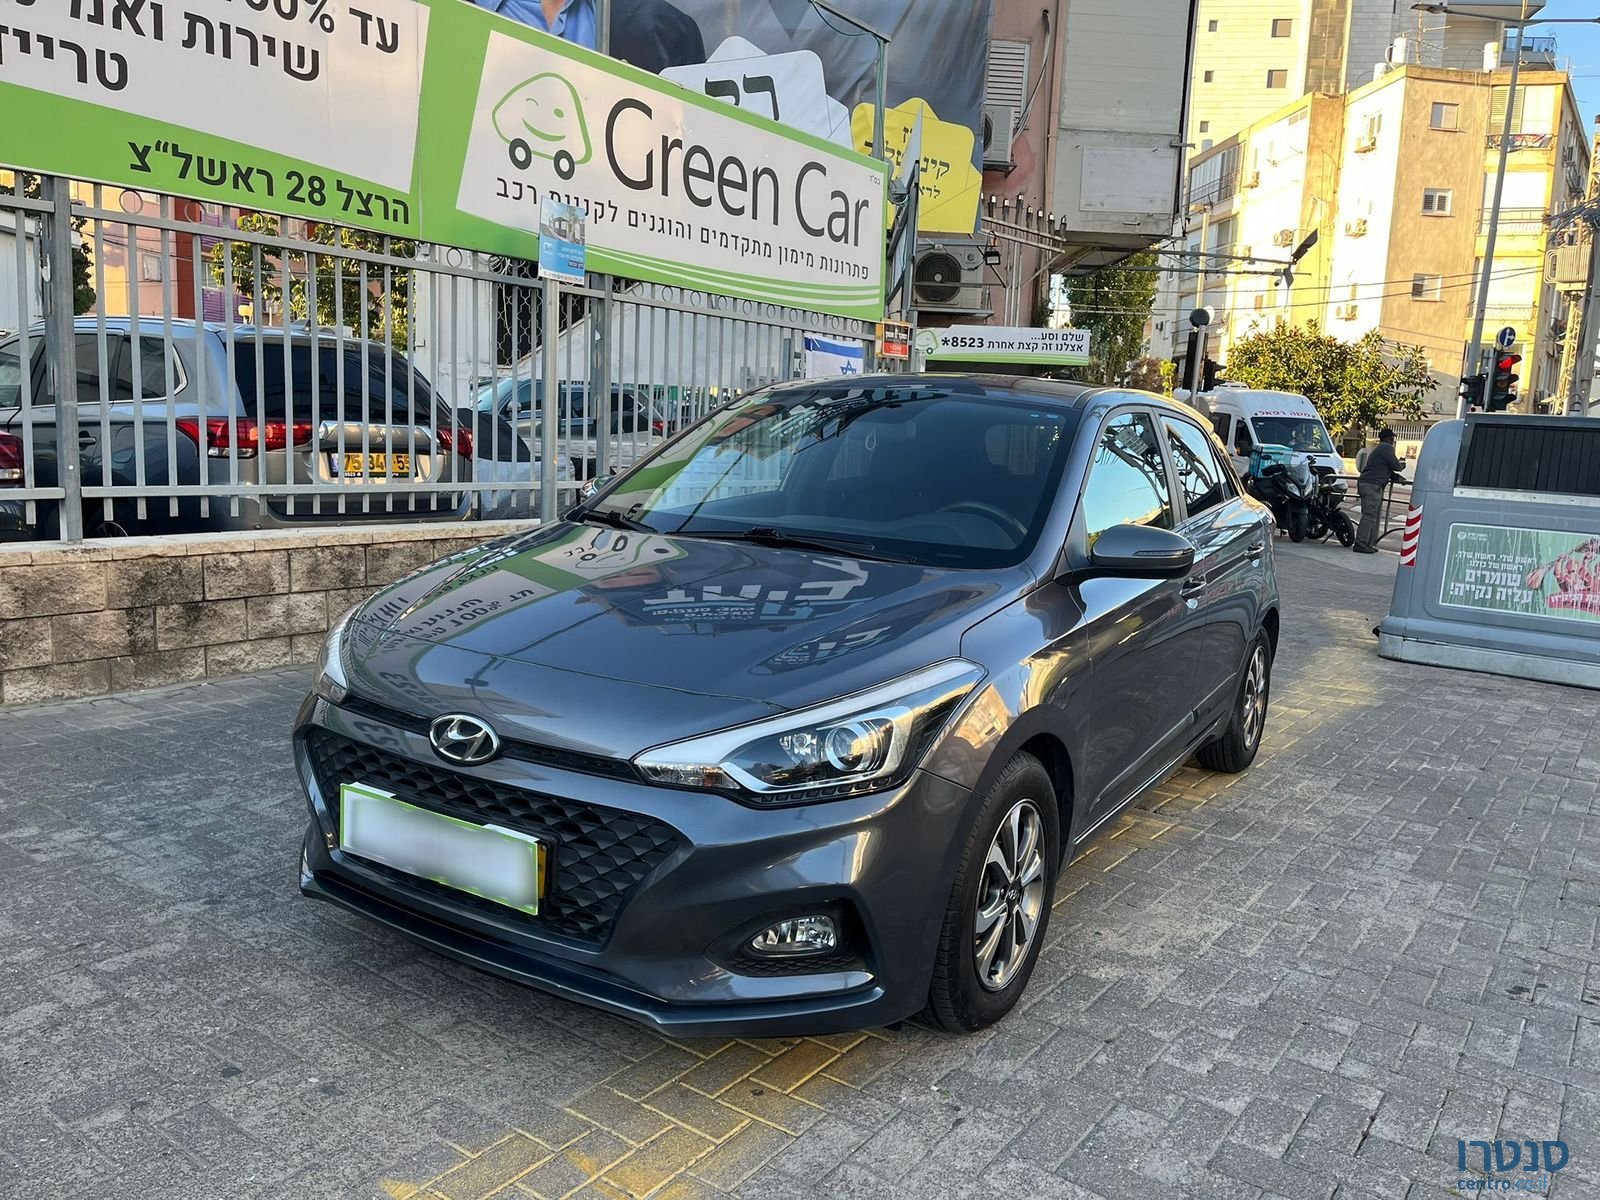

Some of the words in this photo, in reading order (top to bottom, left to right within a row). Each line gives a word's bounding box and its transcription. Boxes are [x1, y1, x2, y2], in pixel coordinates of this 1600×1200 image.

[348, 7, 399, 54] עד
[182, 11, 320, 82] שירות
[605, 98, 779, 226] Green
[795, 161, 869, 247] Car
[285, 170, 327, 207] 28
[496, 177, 537, 205] רכב
[336, 179, 409, 224] הרצל
[628, 209, 692, 240] והוגנים
[700, 226, 773, 259] מתקדמים
[779, 244, 815, 269] מימון
[819, 254, 870, 280] פתרונות
[987, 341, 1015, 350] אחרת
[1018, 341, 1039, 352] קצת
[1042, 343, 1052, 351] זה
[1055, 342, 1084, 352] אצלנו
[1061, 333, 1084, 342] שלם
[1488, 561, 1499, 569] של
[1465, 569, 1521, 587] שומרים
[1496, 587, 1533, 604] עליה
